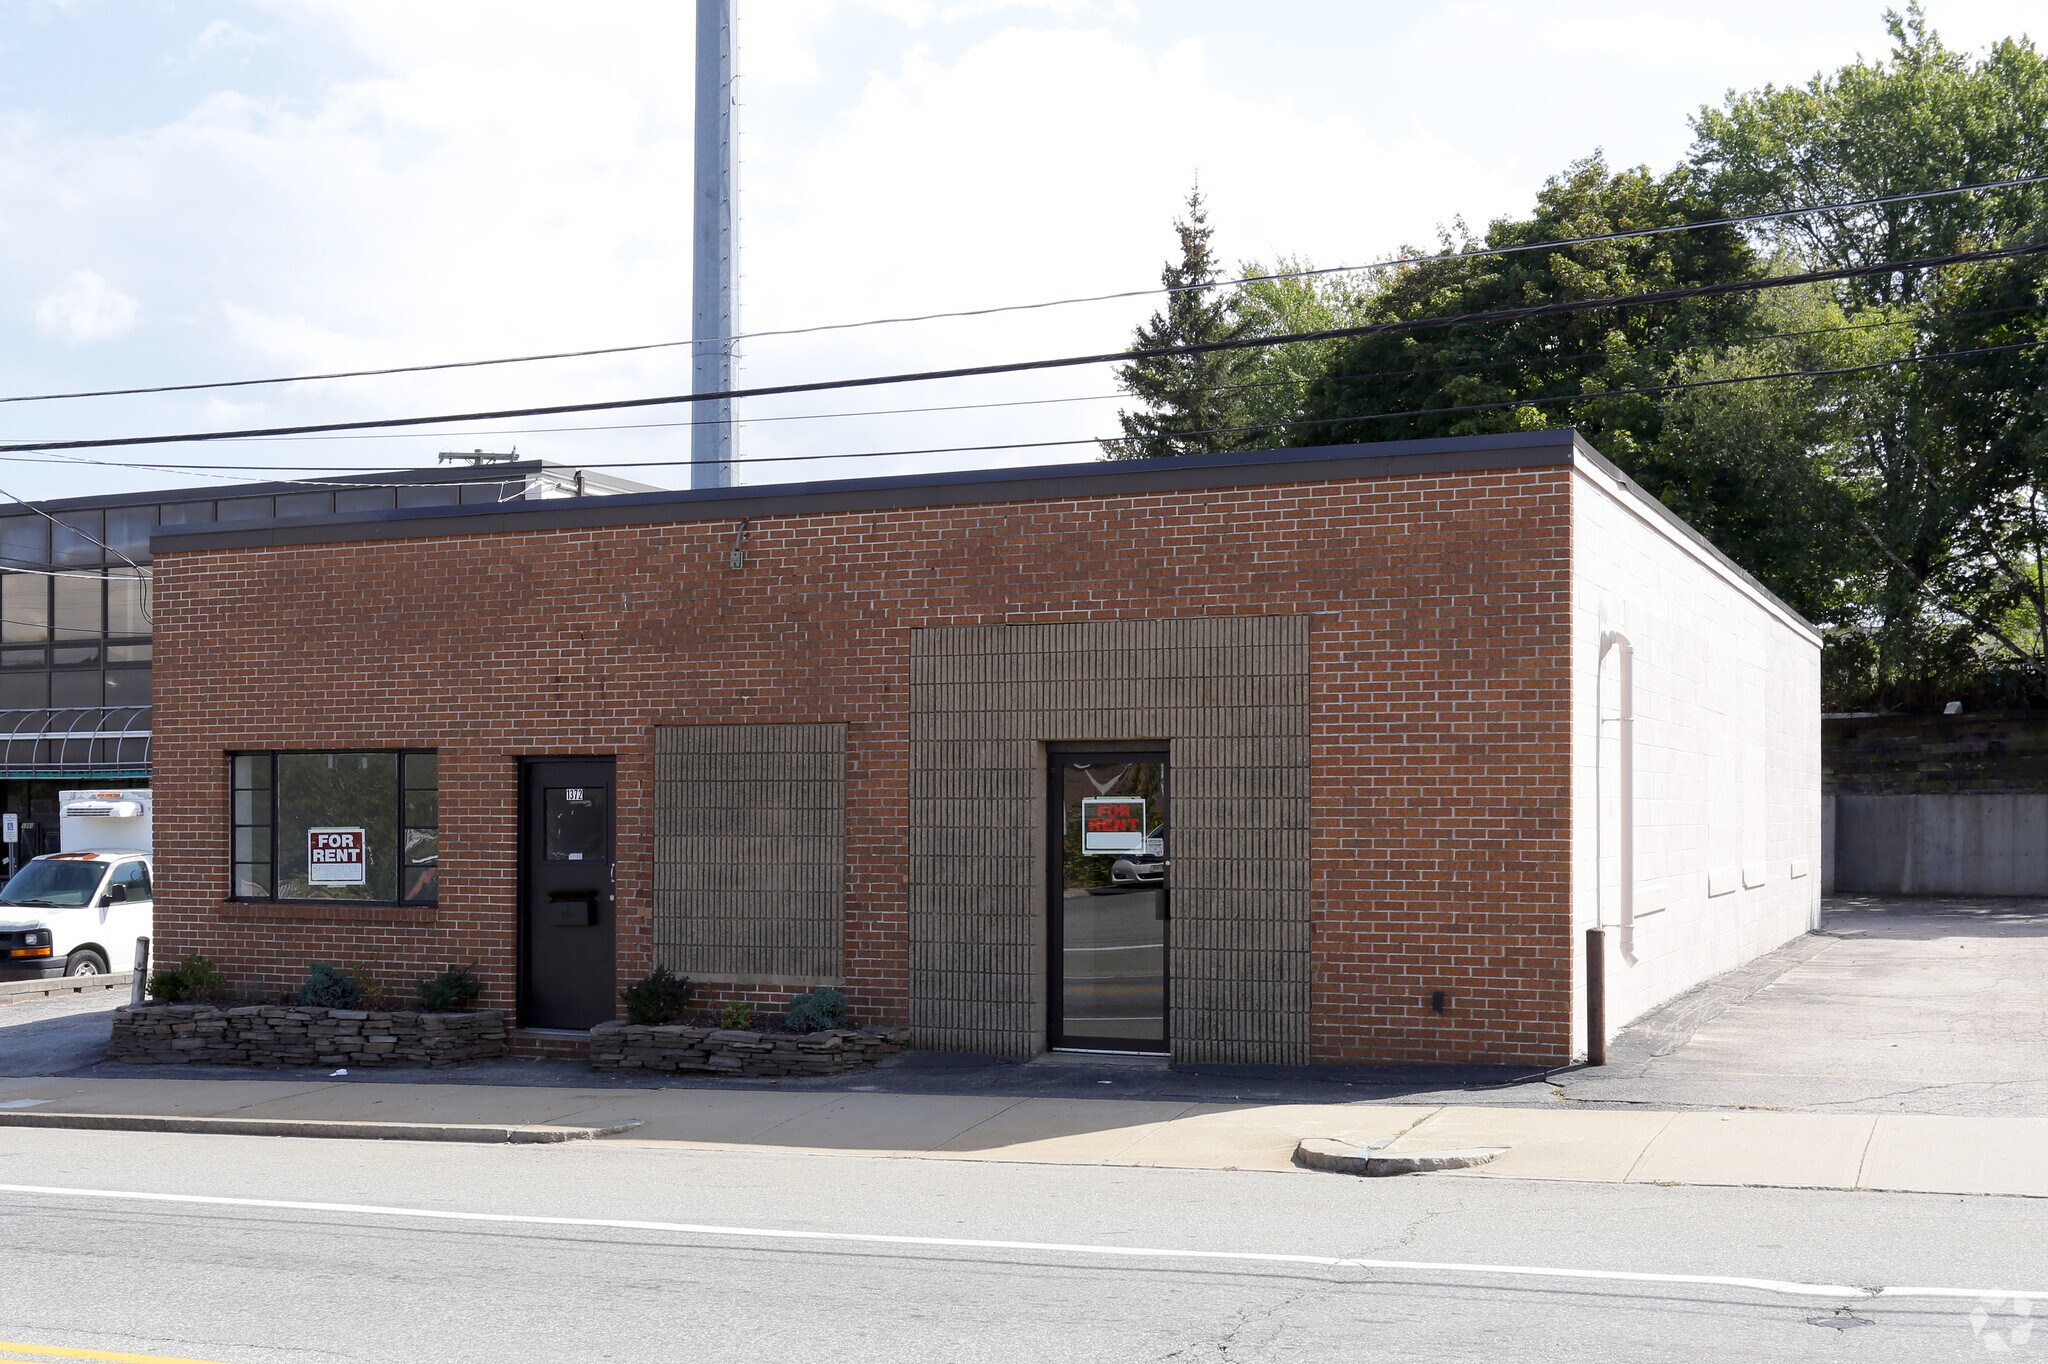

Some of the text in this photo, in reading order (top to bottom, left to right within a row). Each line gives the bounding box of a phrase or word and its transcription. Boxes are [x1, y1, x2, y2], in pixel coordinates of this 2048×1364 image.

[567, 789, 583, 800] 1372
[1096, 804, 1131, 817] FOR
[1087, 818, 1140, 831] RENT
[318, 834, 354, 848] FOR
[312, 848, 361, 862] RENT
